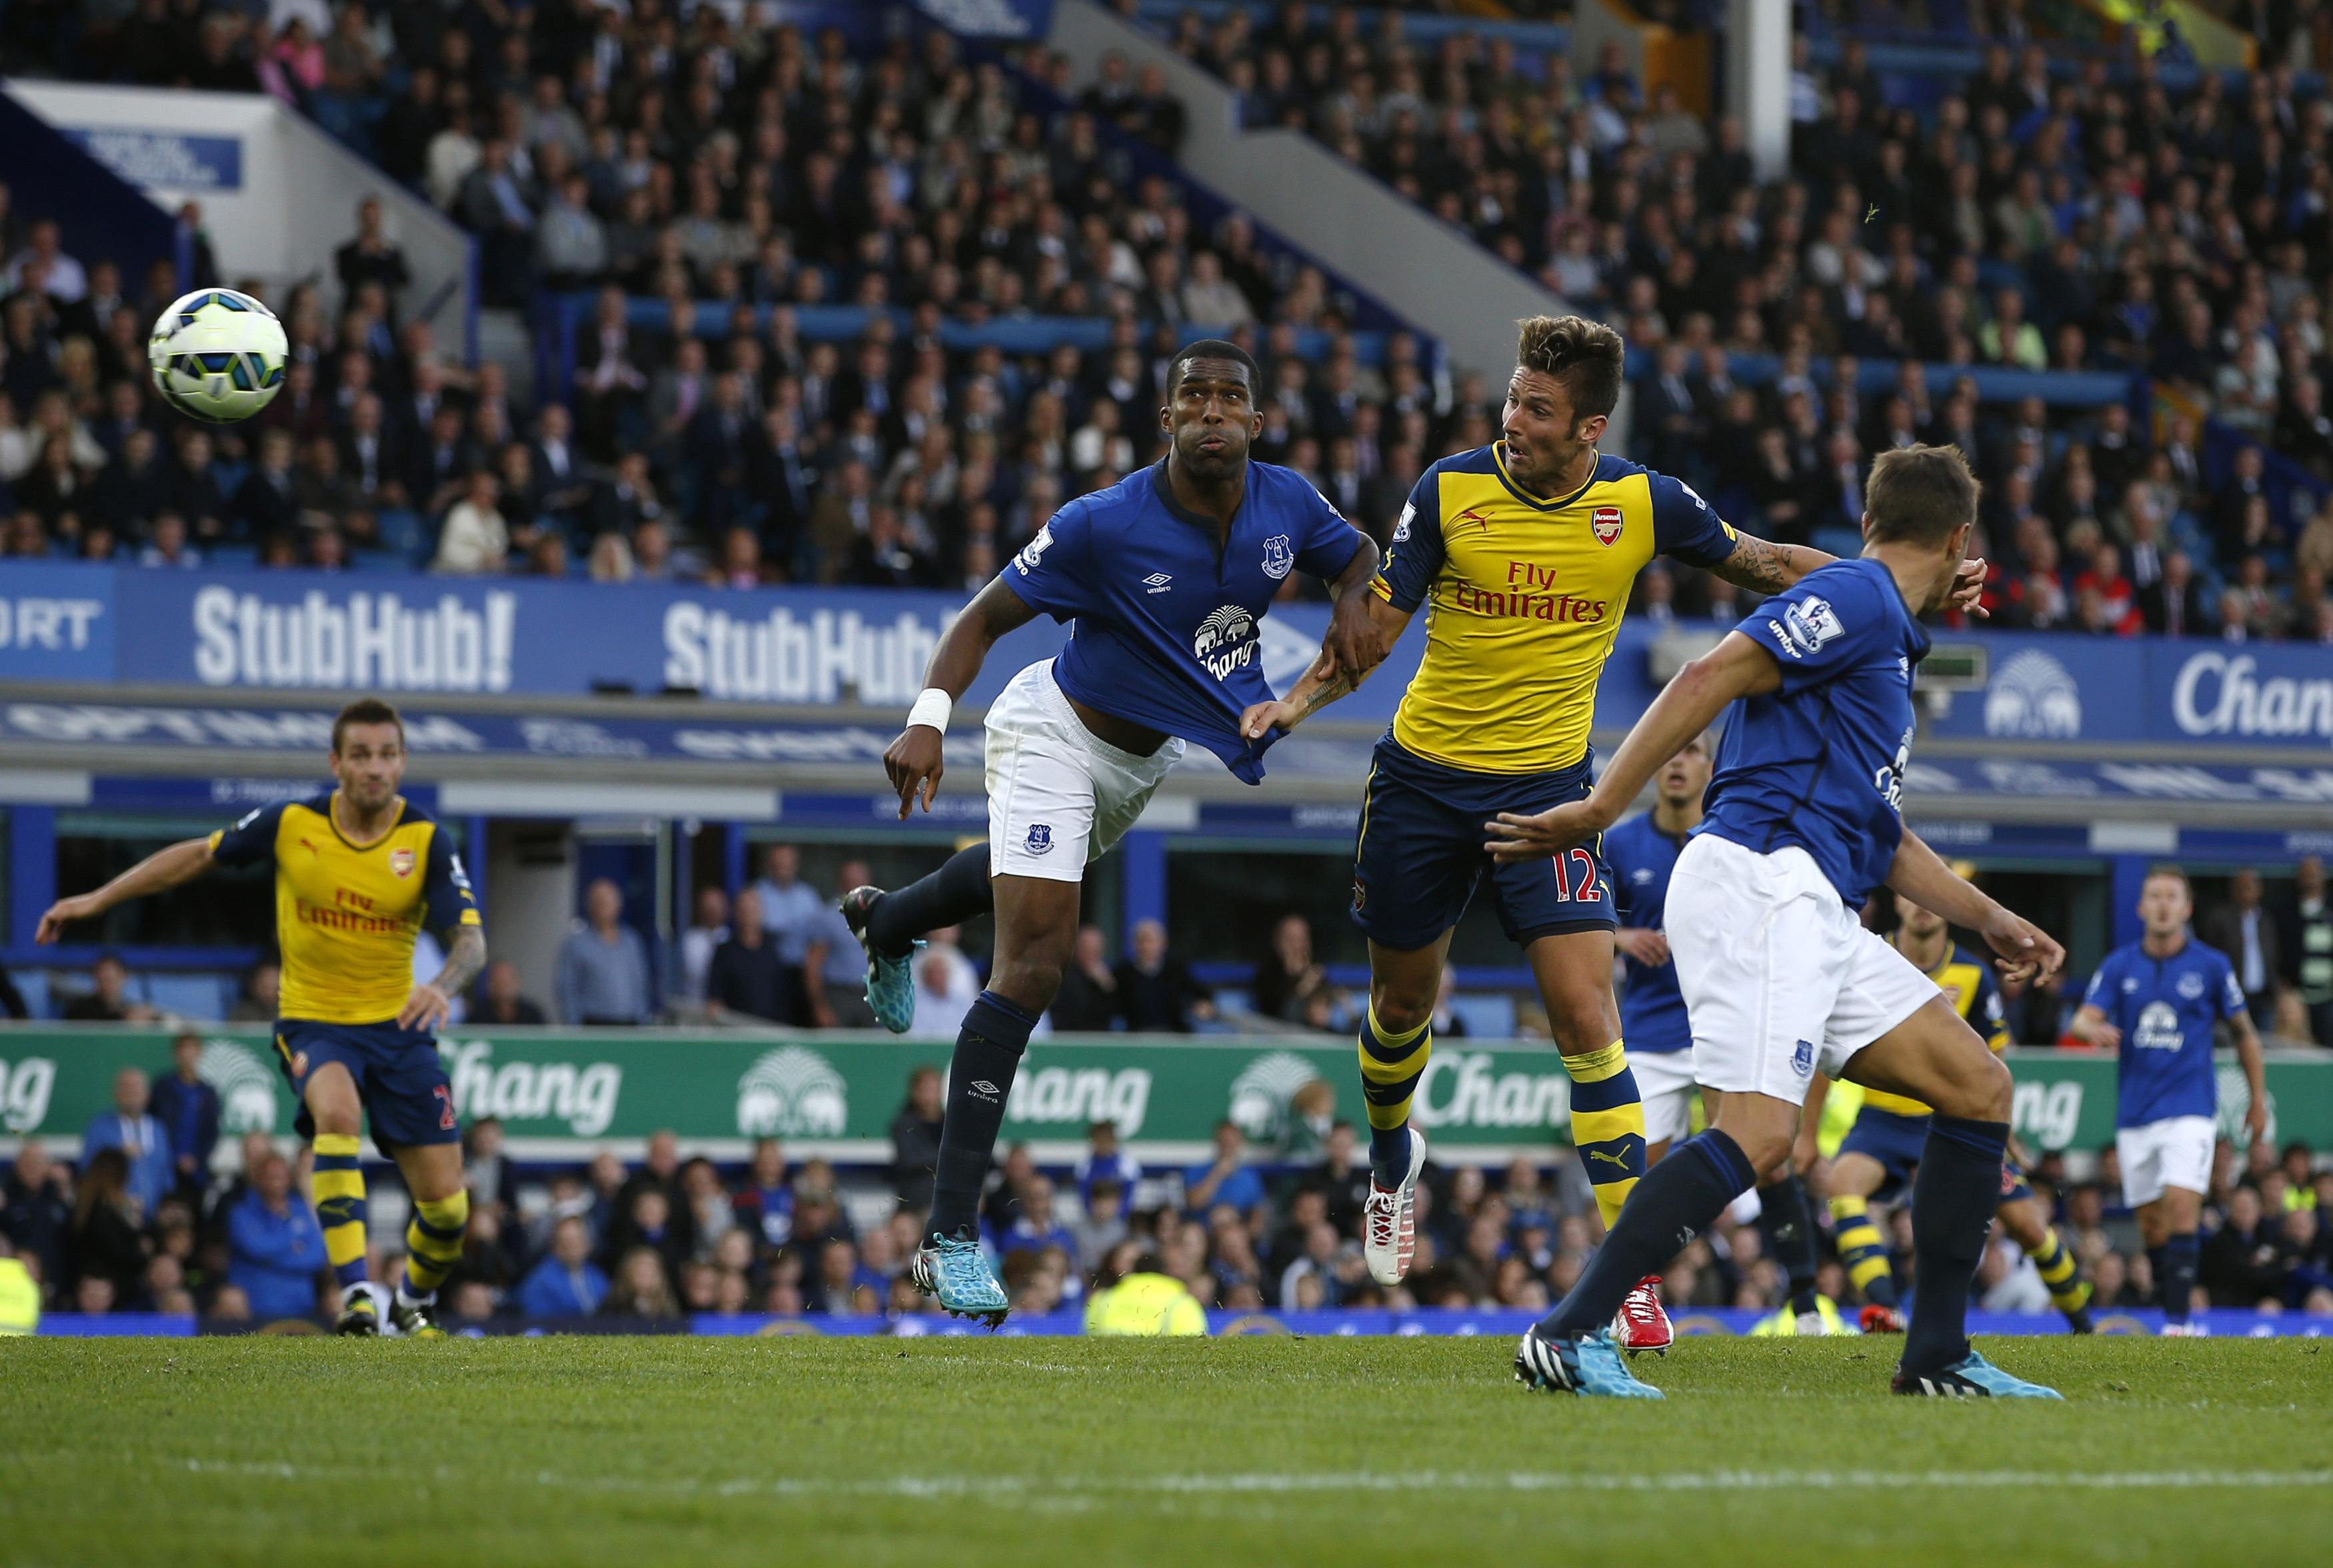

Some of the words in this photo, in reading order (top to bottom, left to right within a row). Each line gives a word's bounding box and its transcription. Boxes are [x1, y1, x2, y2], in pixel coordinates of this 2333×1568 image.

[1013, 553, 1029, 576] bro
[1507, 560, 1556, 591] Fly
[1147, 585, 1171, 594] umbro
[1456, 578, 1607, 623] Emirates
[193, 584, 517, 693] StubHub!
[663, 600, 960, 705] StubHub
[1200, 638, 1256, 682] hang
[1768, 619, 1802, 659] umbro
[2171, 650, 2333, 737] Chan
[1552, 848, 1602, 902] 12
[335, 888, 374, 912] Fly
[438, 1040, 624, 1138] hang
[943, 1048, 1153, 1138] hang
[967, 1090, 999, 1104] umbro
[1412, 1048, 1571, 1128] Chan
